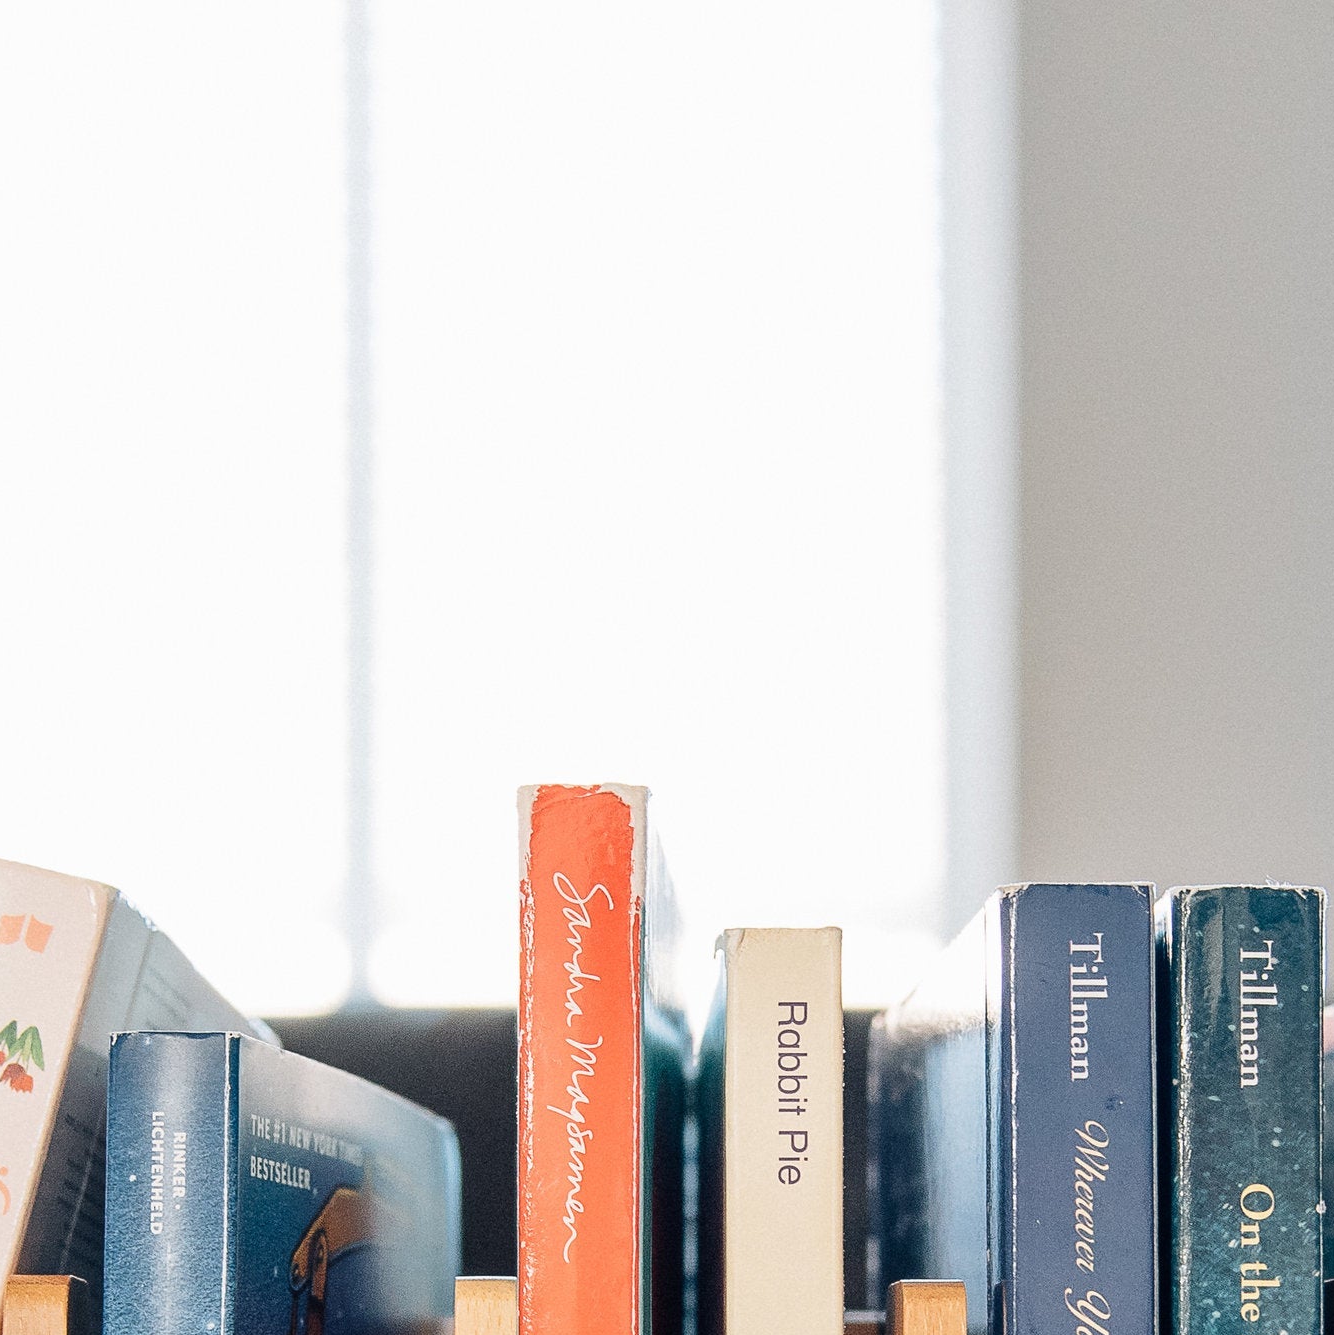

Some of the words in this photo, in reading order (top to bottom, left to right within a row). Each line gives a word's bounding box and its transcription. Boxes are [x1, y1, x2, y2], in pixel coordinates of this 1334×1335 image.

[553, 872, 614, 1028] Sandra
[1067, 932, 1109, 1082] Tillman
[1239, 940, 1279, 1088] Tillman
[777, 1001, 808, 1116] Rabbit
[149, 1111, 165, 1236] LICHTENHELD
[173, 1131, 187, 1199] RINKER
[250, 1155, 311, 1191] BESTSELLER
[251, 1114, 270, 1141] THE
[273, 1119, 286, 1144] #1
[288, 1123, 310, 1151] NEW
[777, 1129, 809, 1185] Pie
[1072, 1119, 1111, 1273] Wherever
[1239, 1183, 1275, 1247] On
[1240, 1261, 1281, 1323] the
